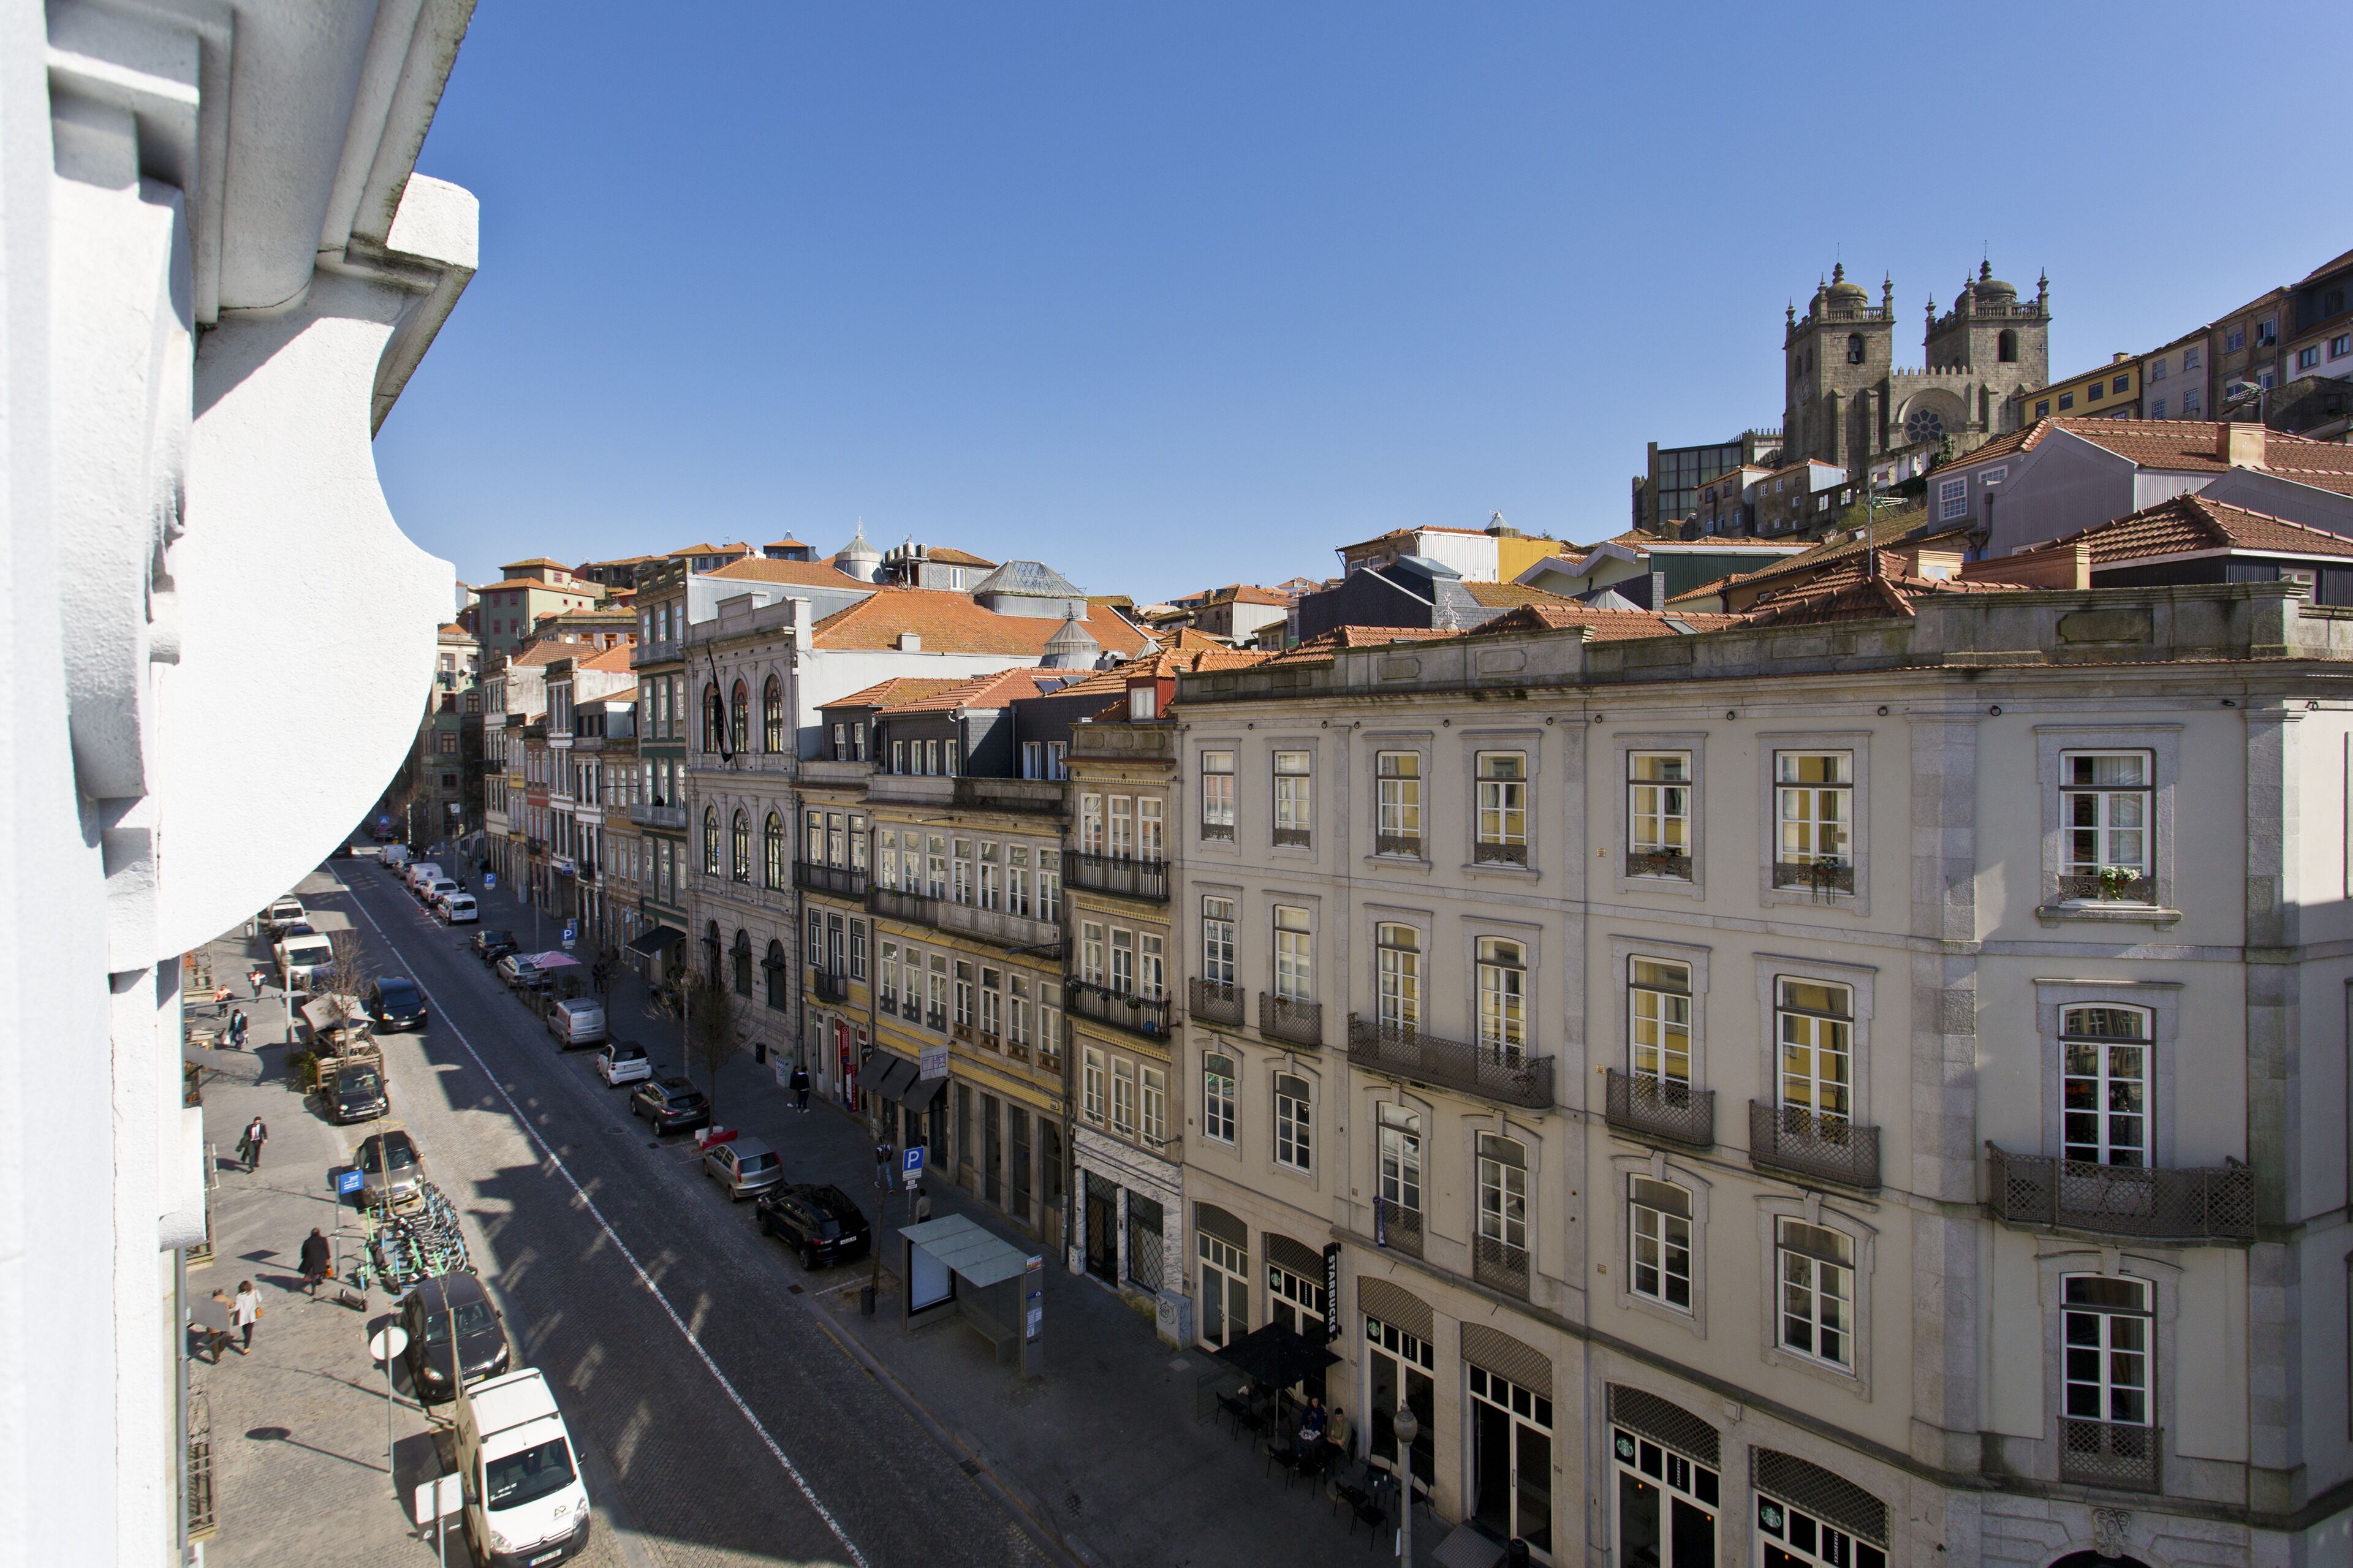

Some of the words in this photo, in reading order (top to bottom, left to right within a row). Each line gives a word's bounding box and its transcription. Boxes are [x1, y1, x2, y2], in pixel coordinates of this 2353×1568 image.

[486, 874, 493, 882] P
[564, 930, 572, 940] P
[907, 1151, 920, 1168] P
